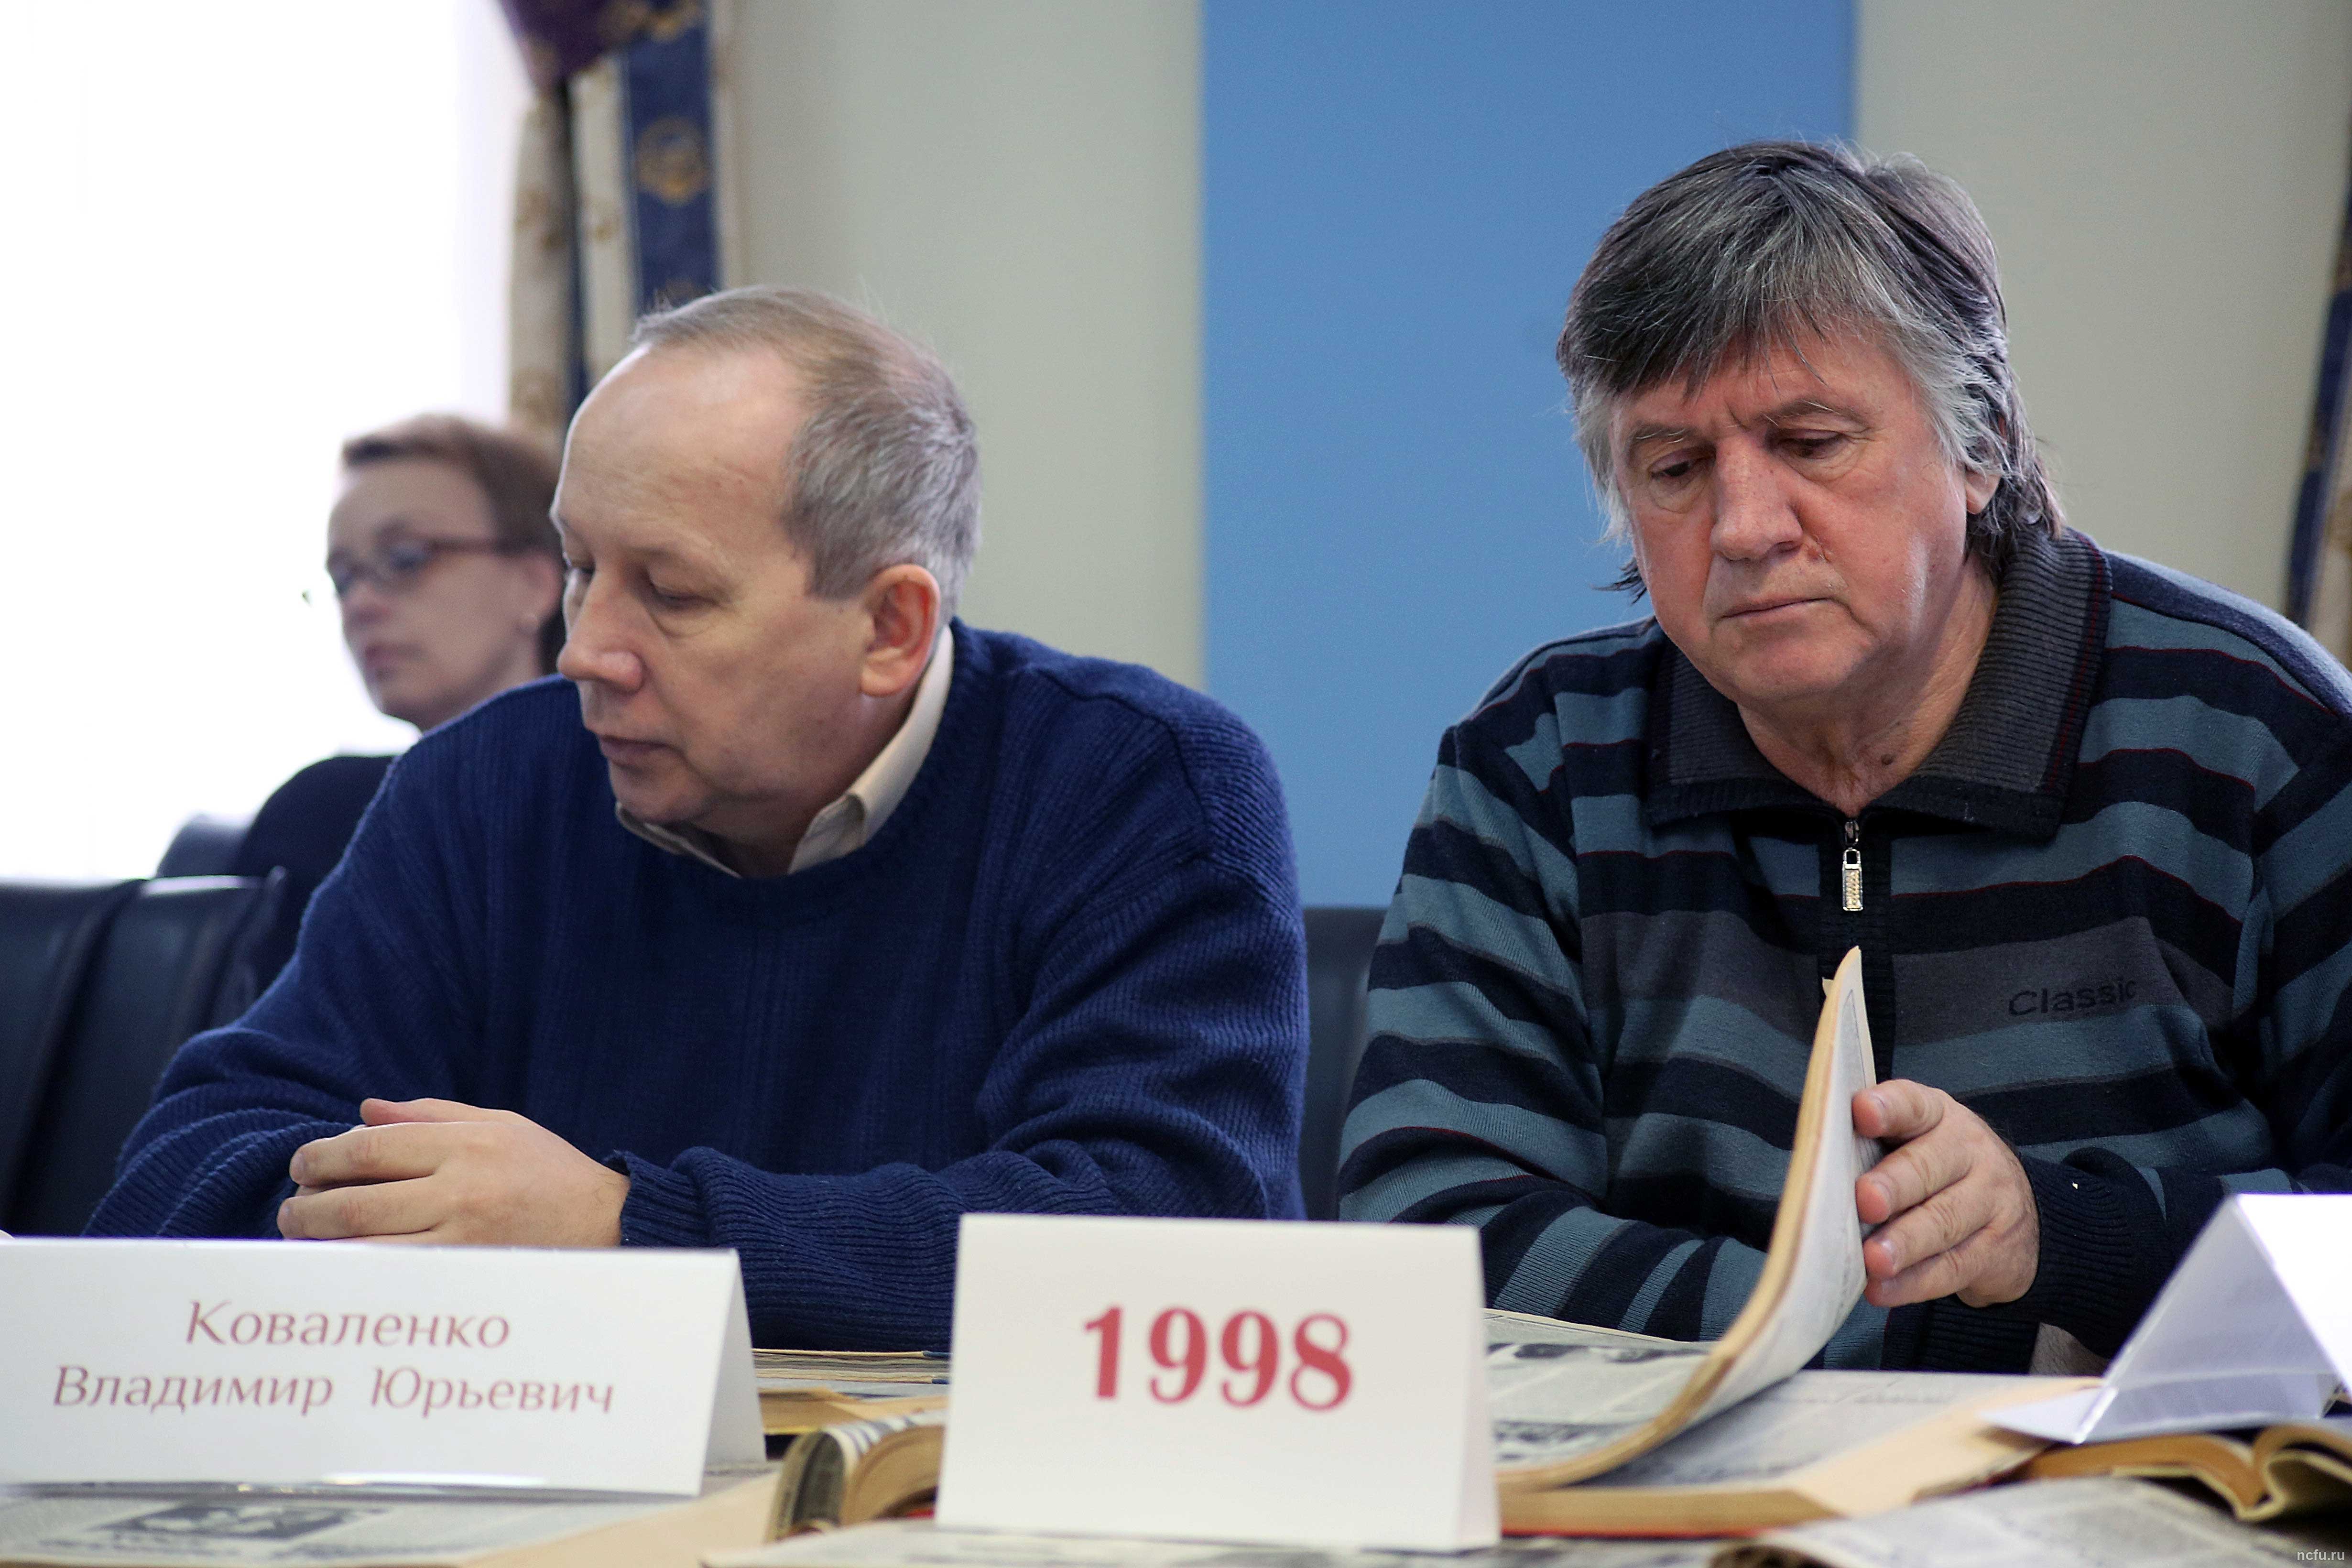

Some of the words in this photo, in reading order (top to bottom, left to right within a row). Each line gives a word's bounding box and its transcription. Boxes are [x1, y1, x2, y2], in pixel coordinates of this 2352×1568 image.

[2008, 977, 2136, 1016] Classic
[186, 1300, 510, 1348] Коваленко
[1085, 1304, 1354, 1411] 1998
[54, 1365, 333, 1415] Владимир
[371, 1366, 615, 1418] Юрьевич
